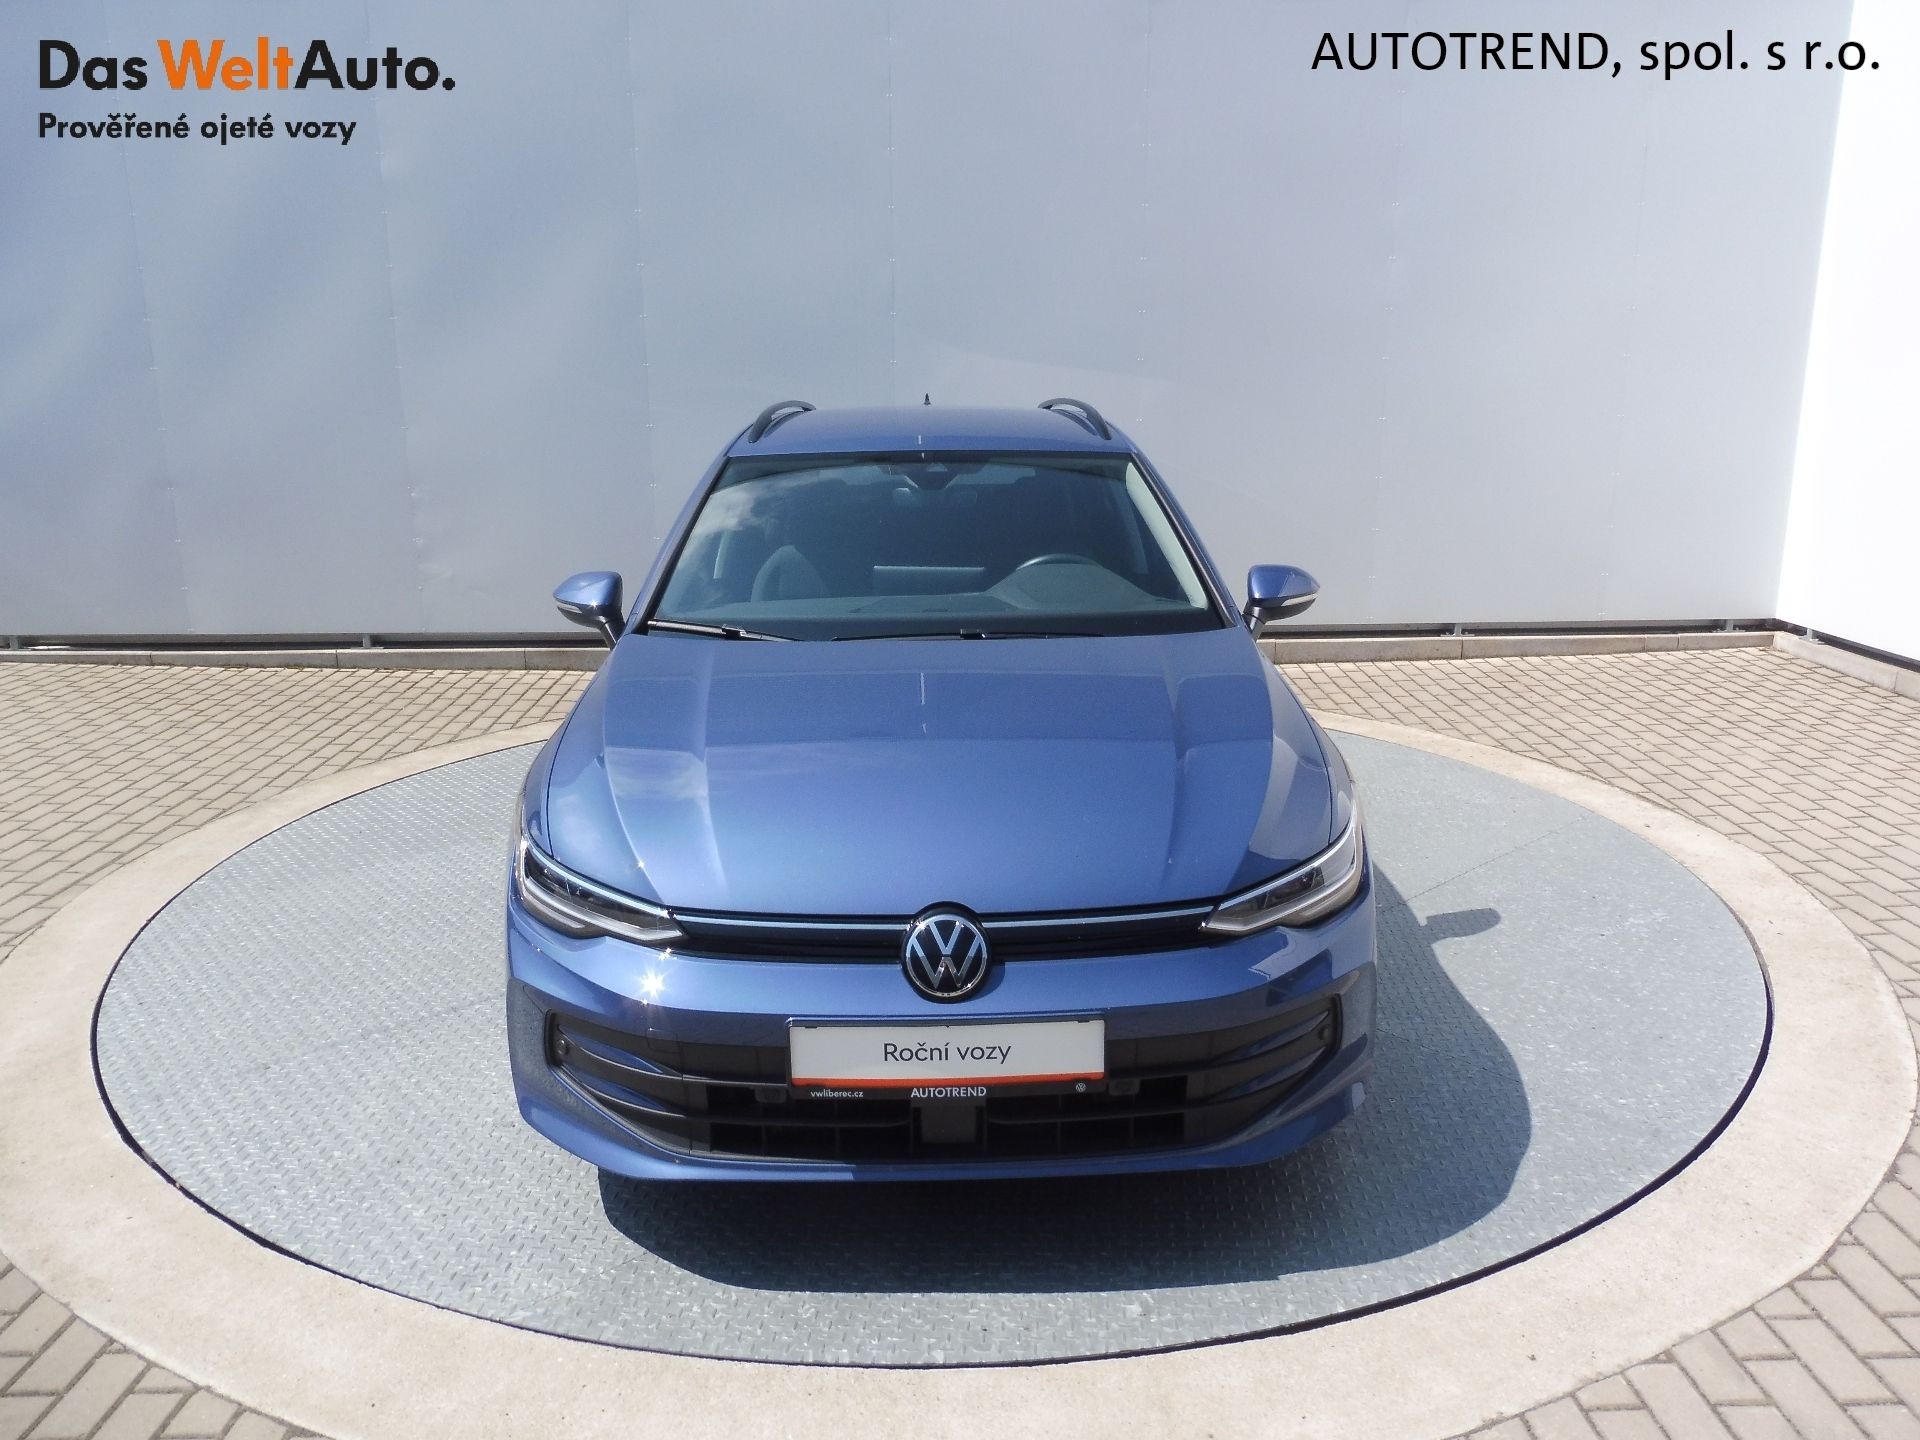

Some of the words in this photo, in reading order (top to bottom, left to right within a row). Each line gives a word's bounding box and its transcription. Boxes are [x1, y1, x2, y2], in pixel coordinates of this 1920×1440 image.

[883, 1042, 950, 1062] Roční
[956, 1045, 1012, 1064] vozy
[810, 1089, 864, 1099] vwliberec.cz
[910, 1086, 987, 1098] AUTOTREND
